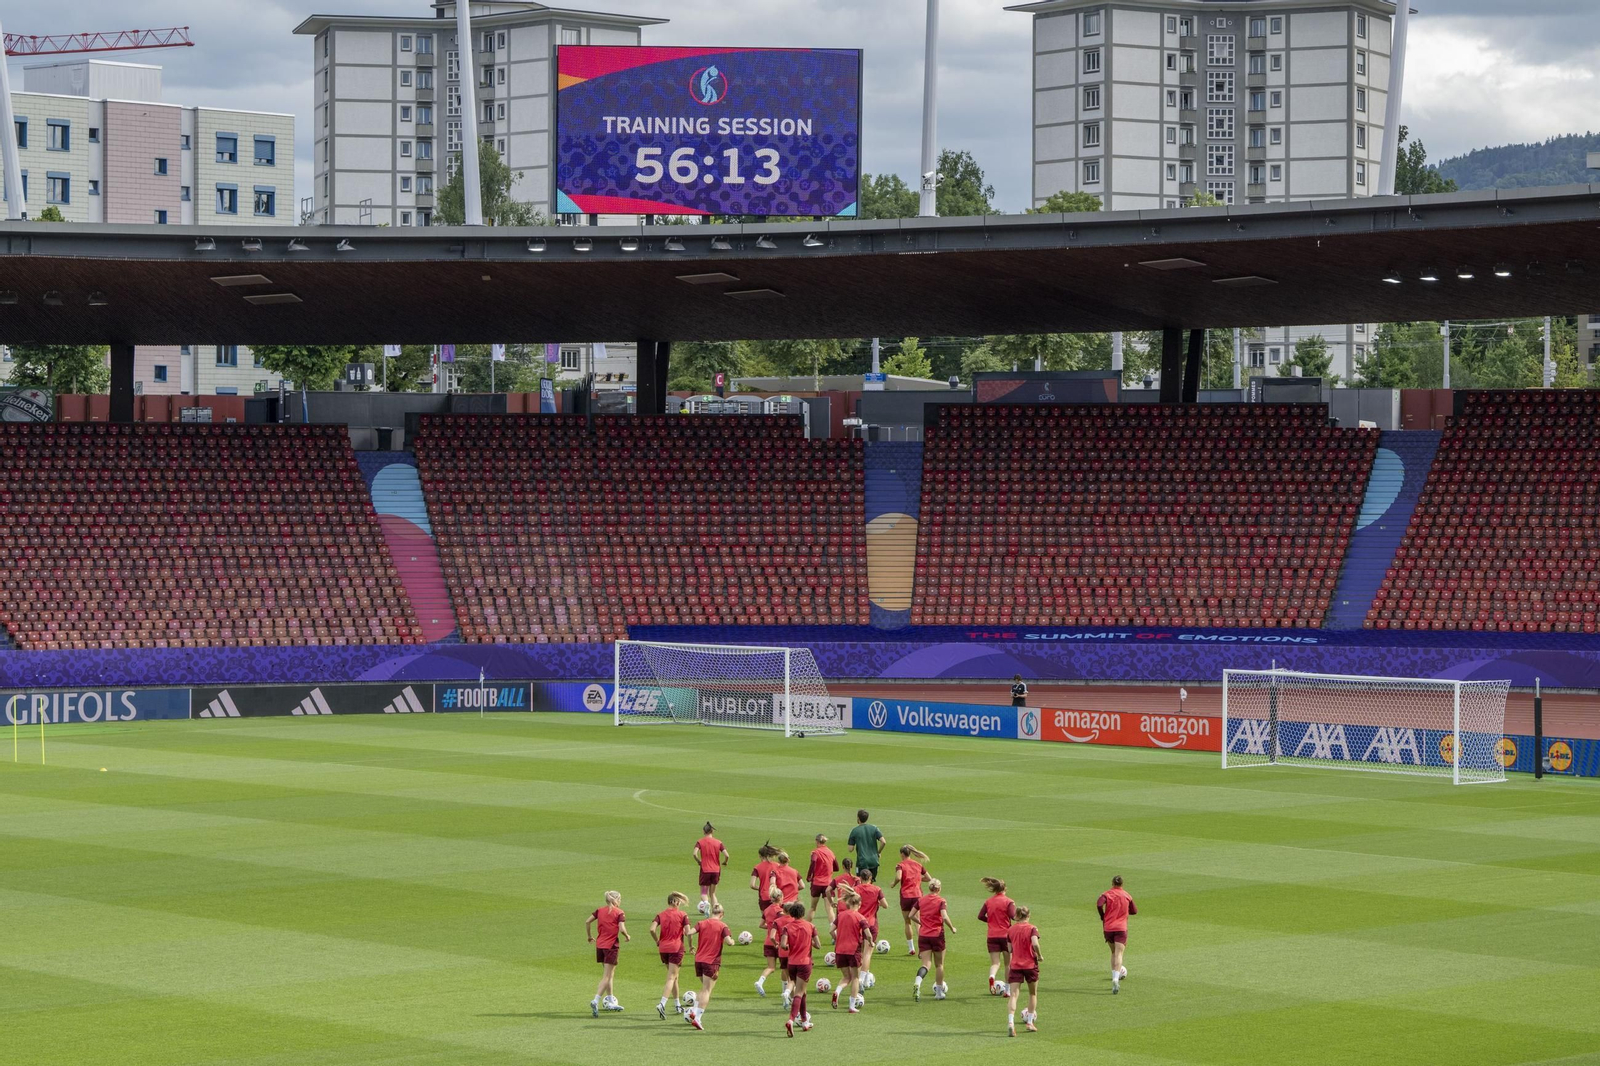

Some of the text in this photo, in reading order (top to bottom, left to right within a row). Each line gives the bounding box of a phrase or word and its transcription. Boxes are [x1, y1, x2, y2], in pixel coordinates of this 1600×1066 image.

[603, 116, 812, 136] TRAINING SESSION
[634, 147, 781, 184] 56:13
[716, 374, 723, 385] C
[3, 395, 49, 422] Heineken
[1023, 632, 1132, 640] SUMMIT
[1178, 634, 1318, 644] EMOTIONS
[441, 687, 525, 708] #FOOTBALL
[587, 690, 602, 699] EA
[5, 691, 137, 725] GRIFOLS
[702, 696, 767, 716] HUBLOT
[779, 700, 846, 720] HUBLOT
[897, 705, 1001, 735] Volkswagen
[1054, 710, 1121, 731] amazon
[1140, 715, 1209, 736] amazon
[1227, 719, 1283, 756] AXA
[1293, 722, 1351, 761] AXA
[1362, 726, 1421, 765] AXA
[1550, 750, 1570, 760] LIDL
